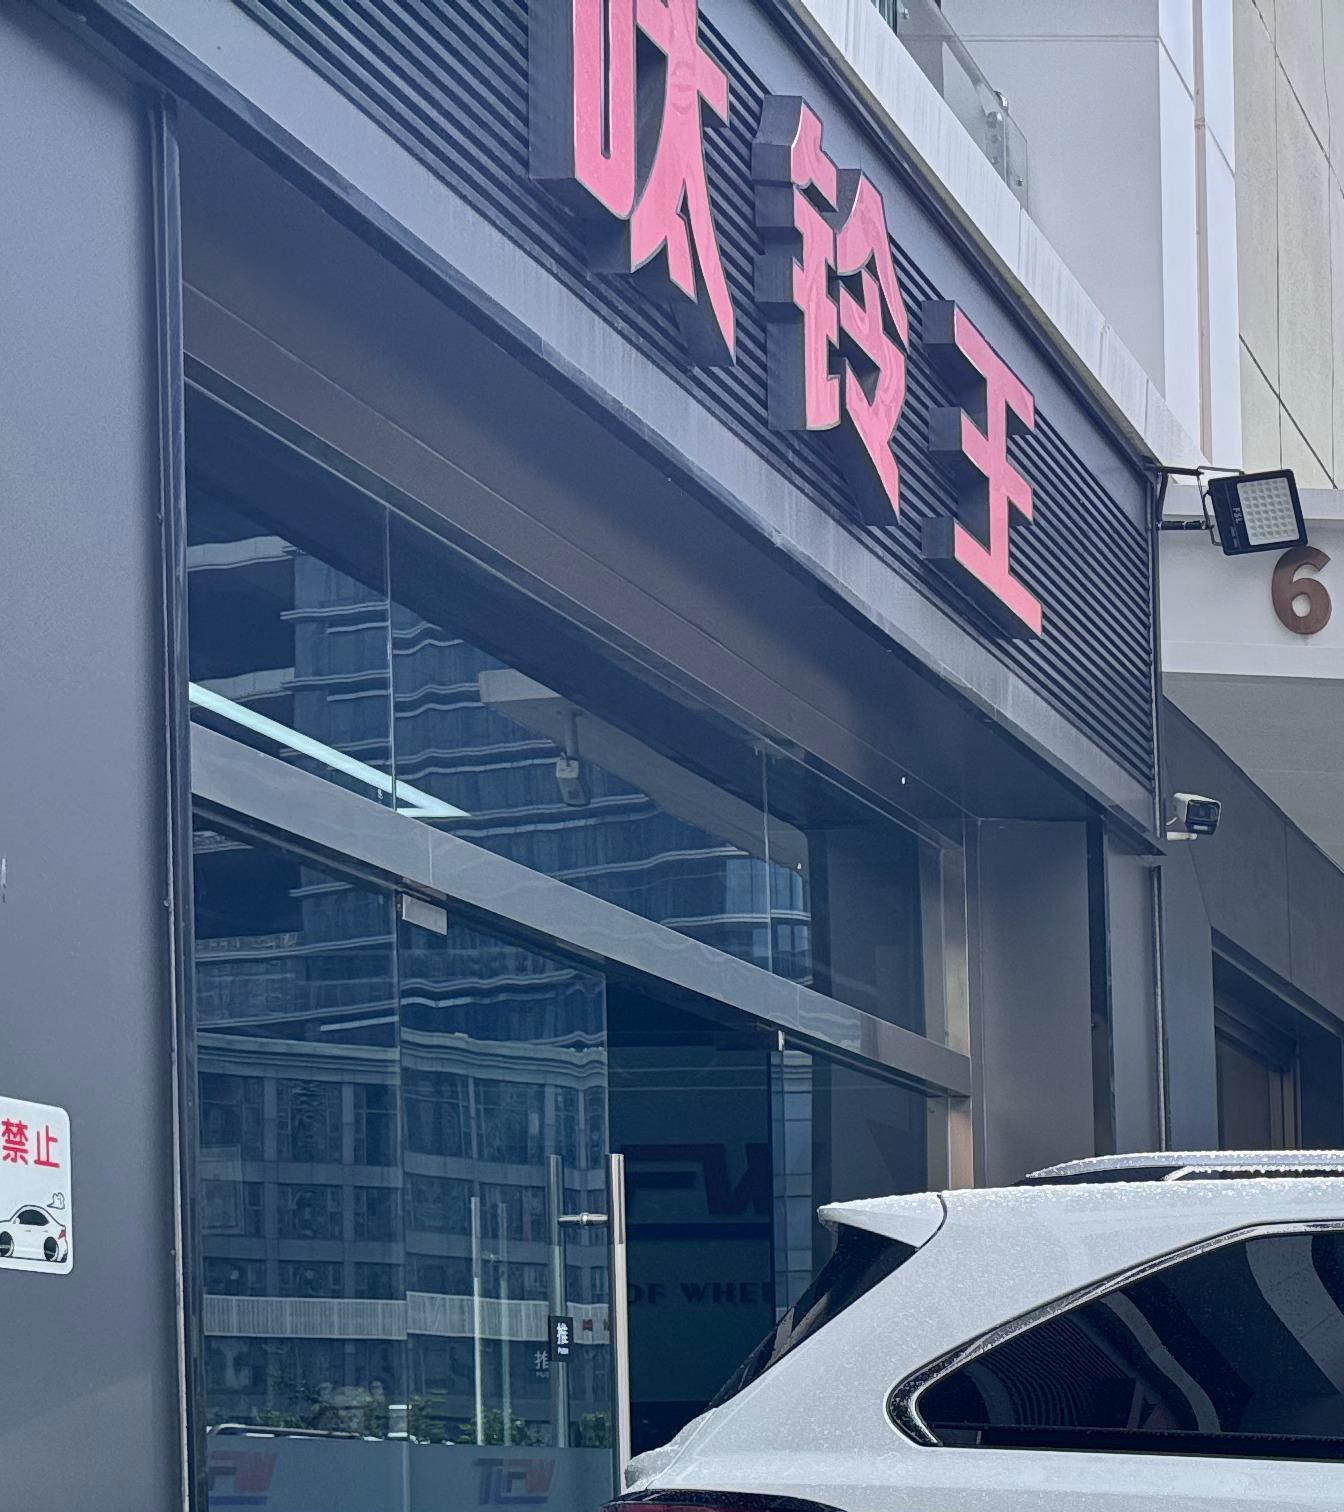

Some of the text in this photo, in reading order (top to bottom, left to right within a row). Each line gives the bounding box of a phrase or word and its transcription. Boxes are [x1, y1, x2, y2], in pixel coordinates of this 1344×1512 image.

[1271, 546, 1333, 635] 6
[1, 1118, 60, 1168] 禁止
[680, 1282, 771, 1303] WHE
